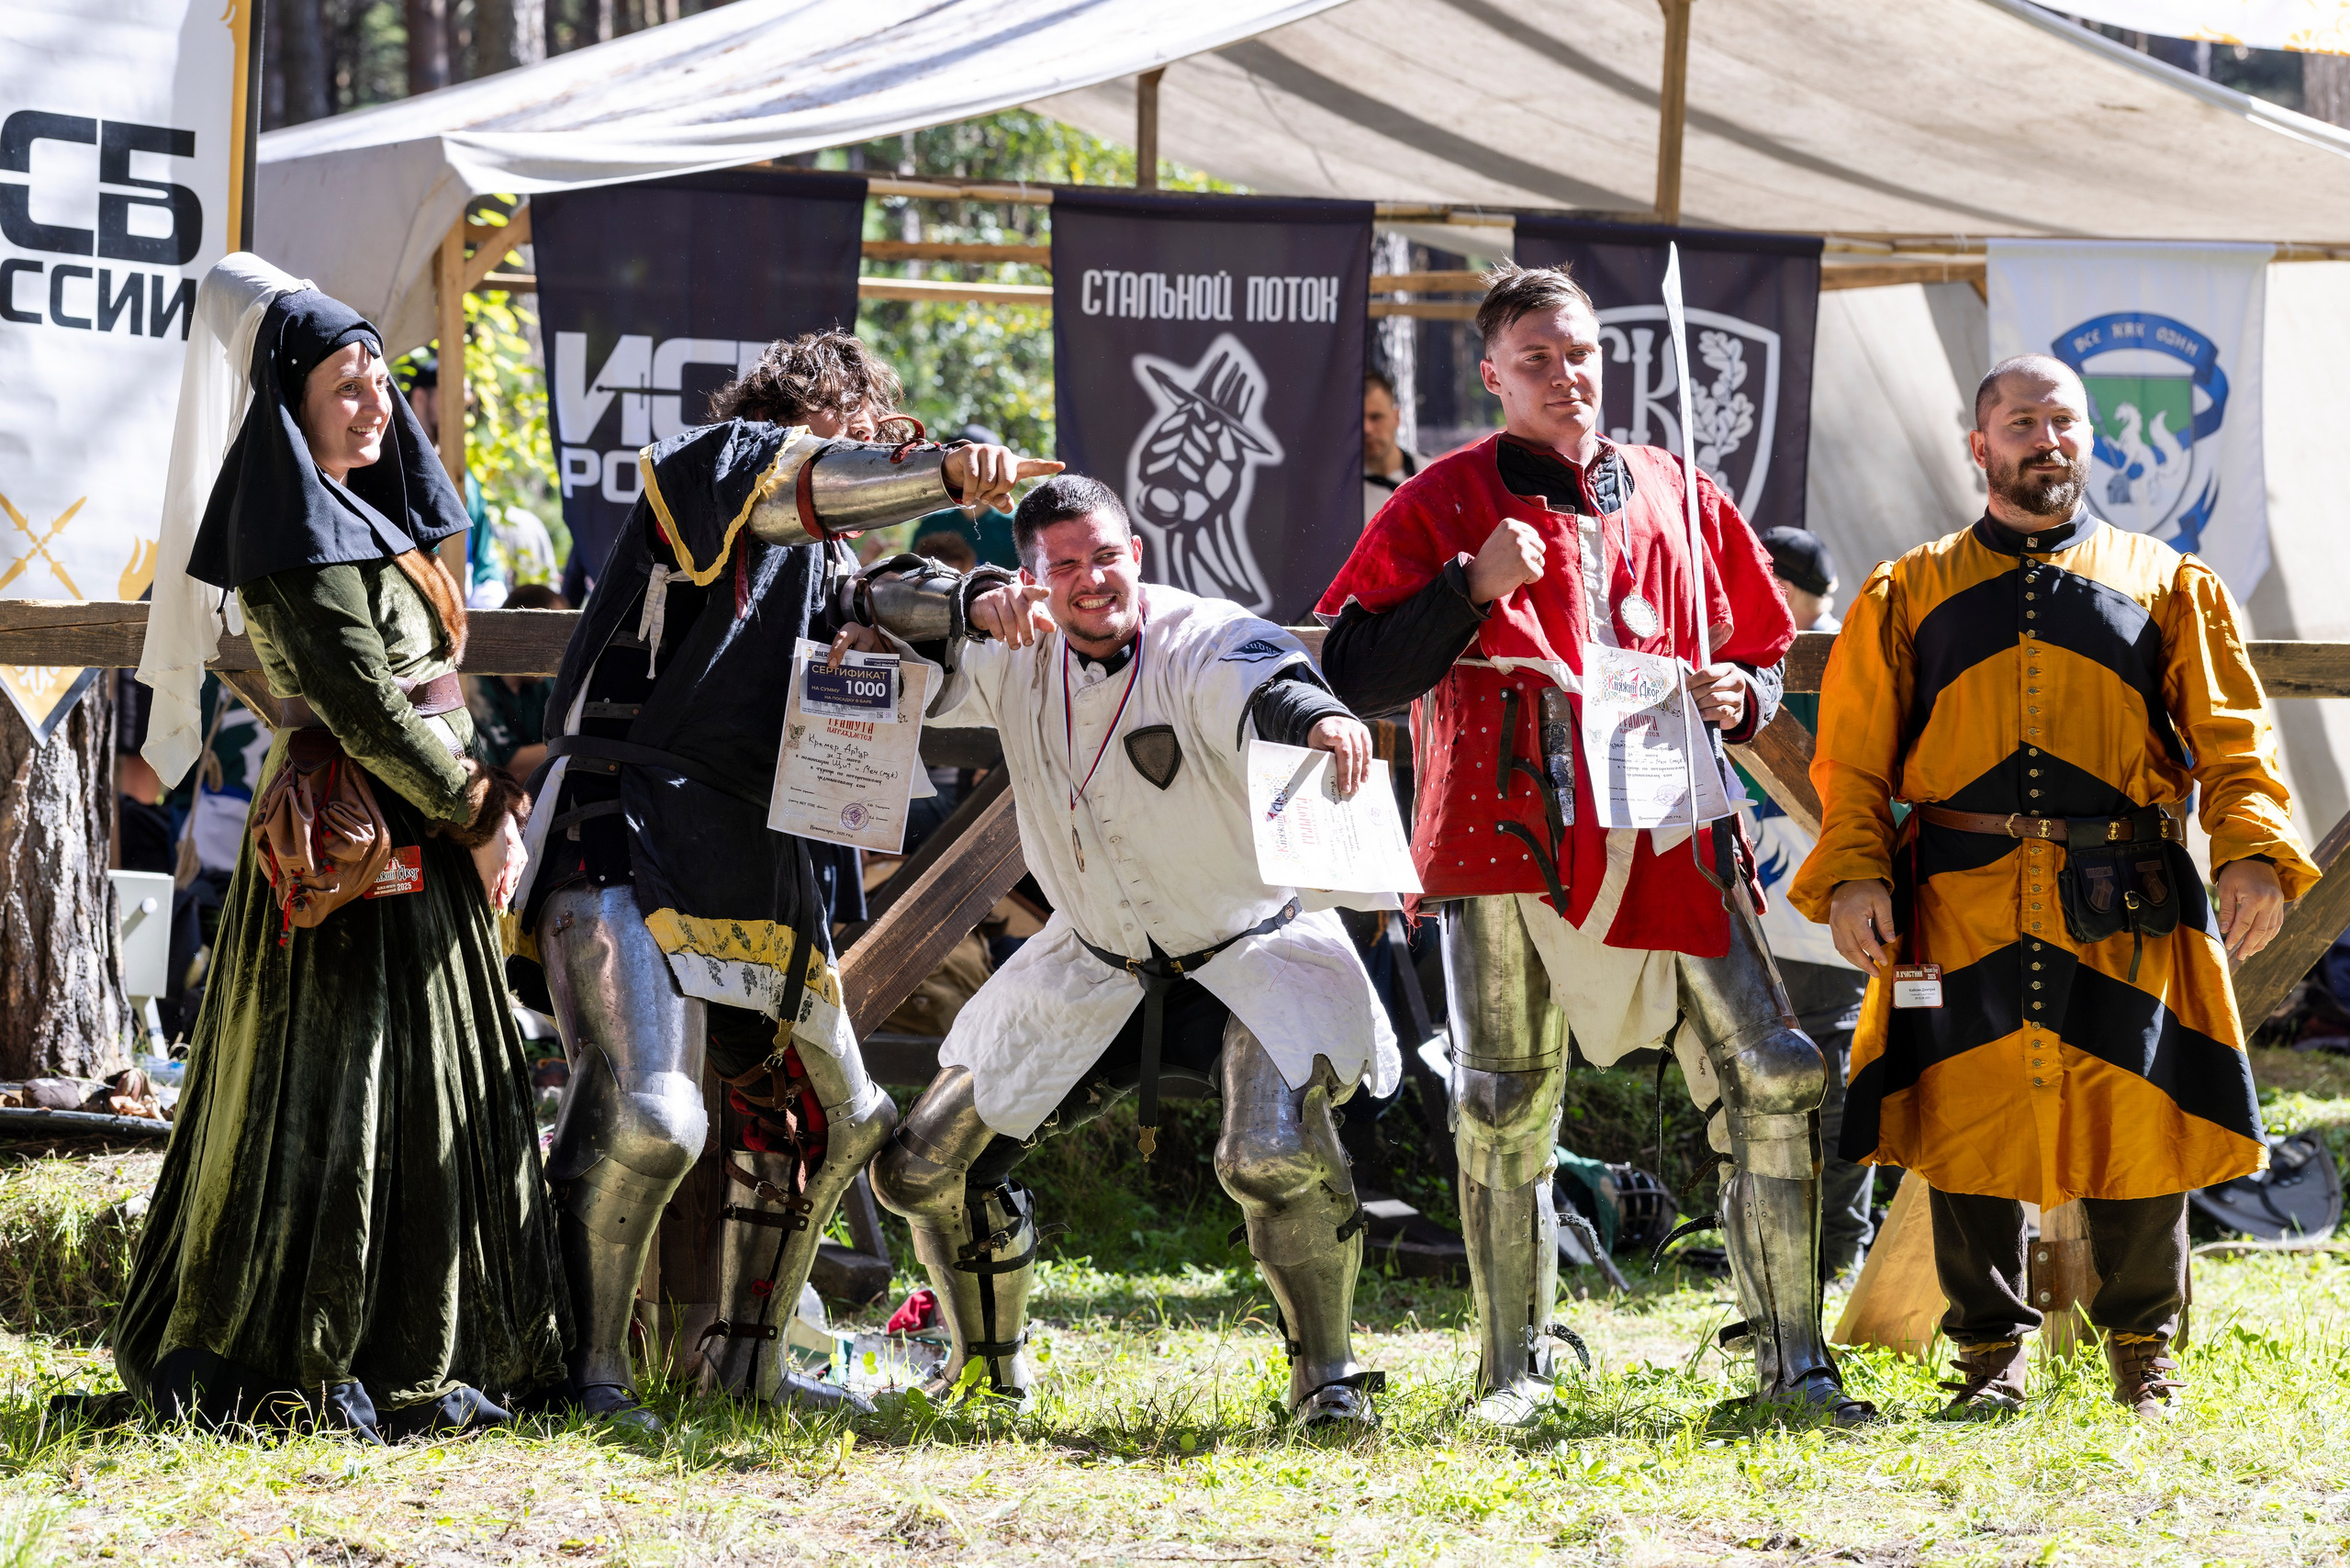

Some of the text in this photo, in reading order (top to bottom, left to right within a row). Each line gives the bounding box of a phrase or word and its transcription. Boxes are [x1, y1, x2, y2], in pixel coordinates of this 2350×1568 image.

[1081, 269, 1338, 324] СТАЛЬНОЙ ПОТОК
[2110, 321, 2145, 340] КАК
[554, 331, 776, 447] ИС
[815, 650, 830, 658] BIER
[811, 665, 888, 680] СЕРТИФИКАТ
[845, 679, 886, 698] 1000
[1608, 674, 1660, 703] Княжий Двор
[1618, 711, 1658, 732] ГРАМОТА
[826, 726, 872, 742] НАГРАЖДАЕТСЯ
[809, 734, 869, 759] Кремер Артур
[397, 882, 412, 891] 2025
